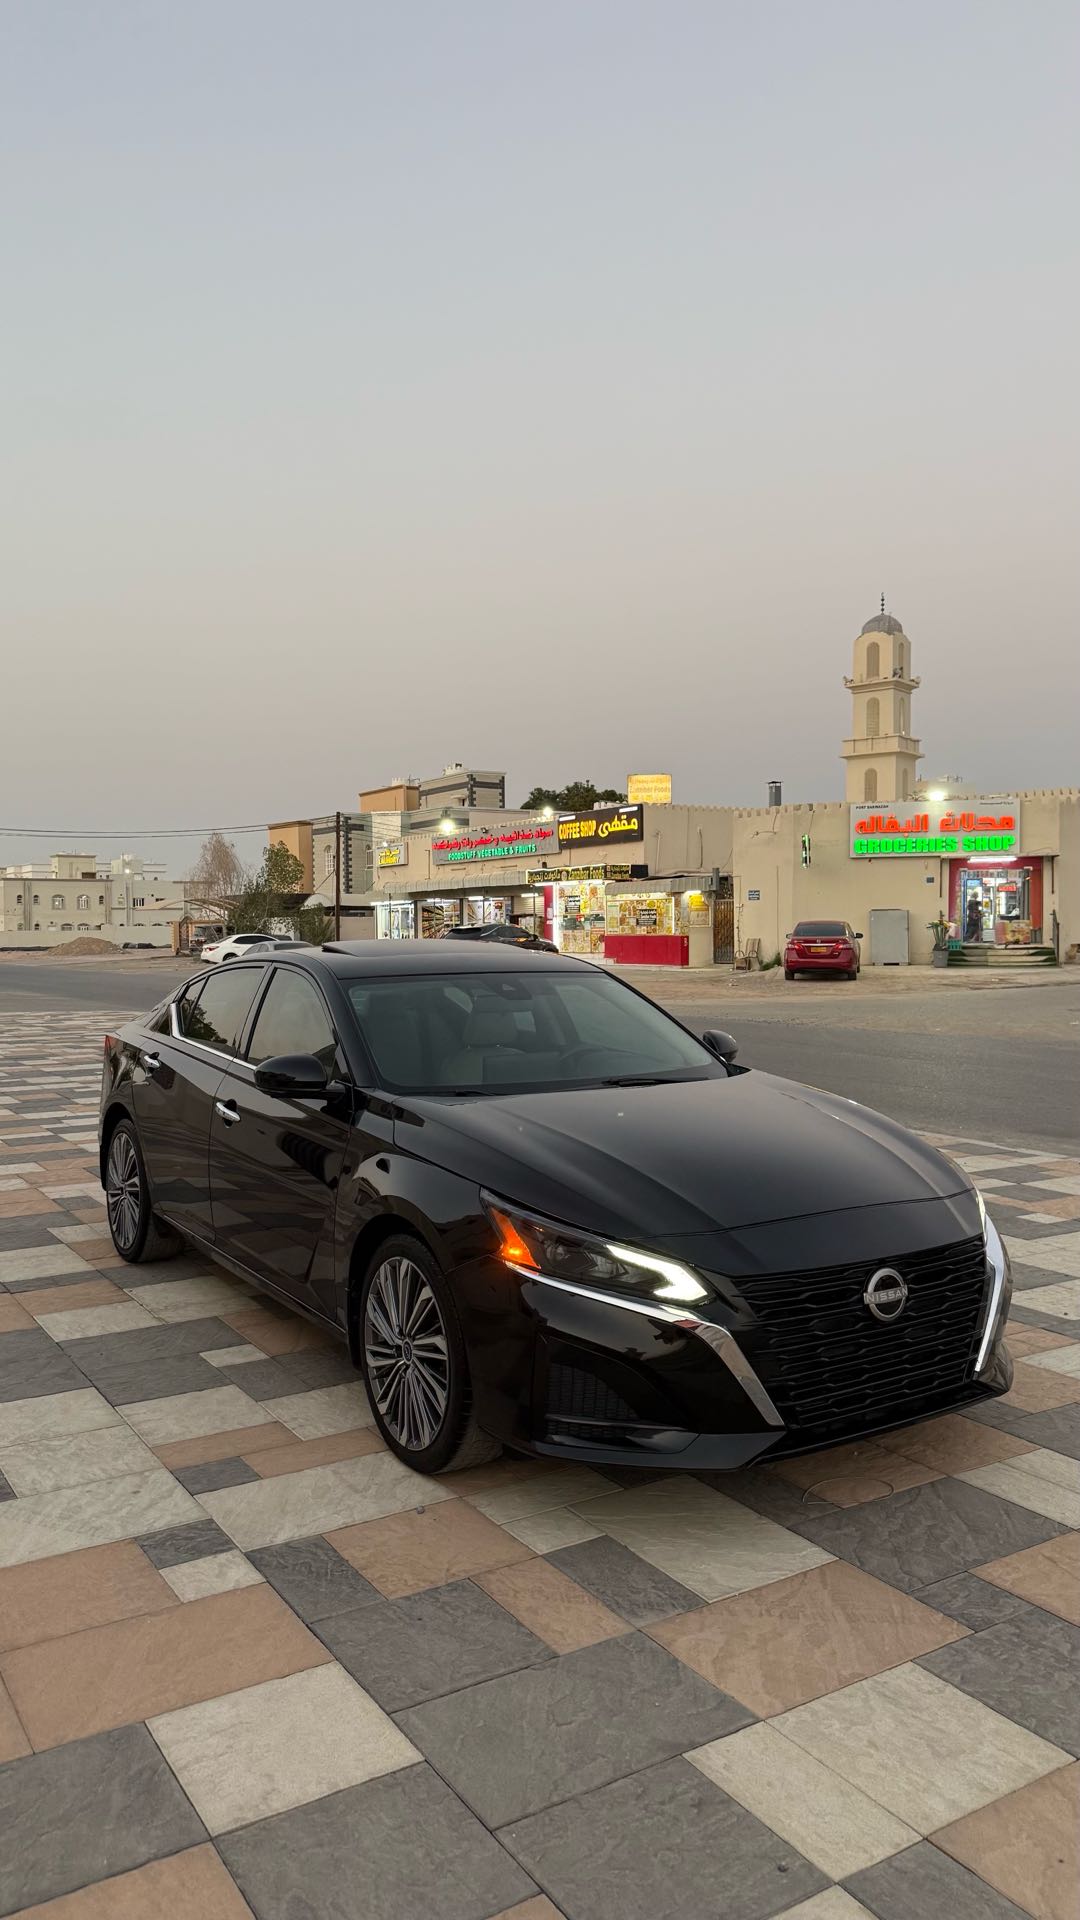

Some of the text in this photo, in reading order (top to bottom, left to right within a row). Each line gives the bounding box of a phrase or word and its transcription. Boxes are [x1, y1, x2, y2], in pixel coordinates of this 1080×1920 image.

[558, 820, 597, 840] COFFEE SHOP
[598, 814, 639, 838] مقهى
[939, 810, 1016, 832] محلات
[448, 850, 477, 861] FOODSTUFF
[478, 846, 509, 859] VEGETABLE
[515, 844, 537, 854] FRUITS
[854, 834, 1016, 854] GROCERIES SHOP
[590, 866, 604, 880] Foods
[866, 1286, 908, 1303] NISSAN
